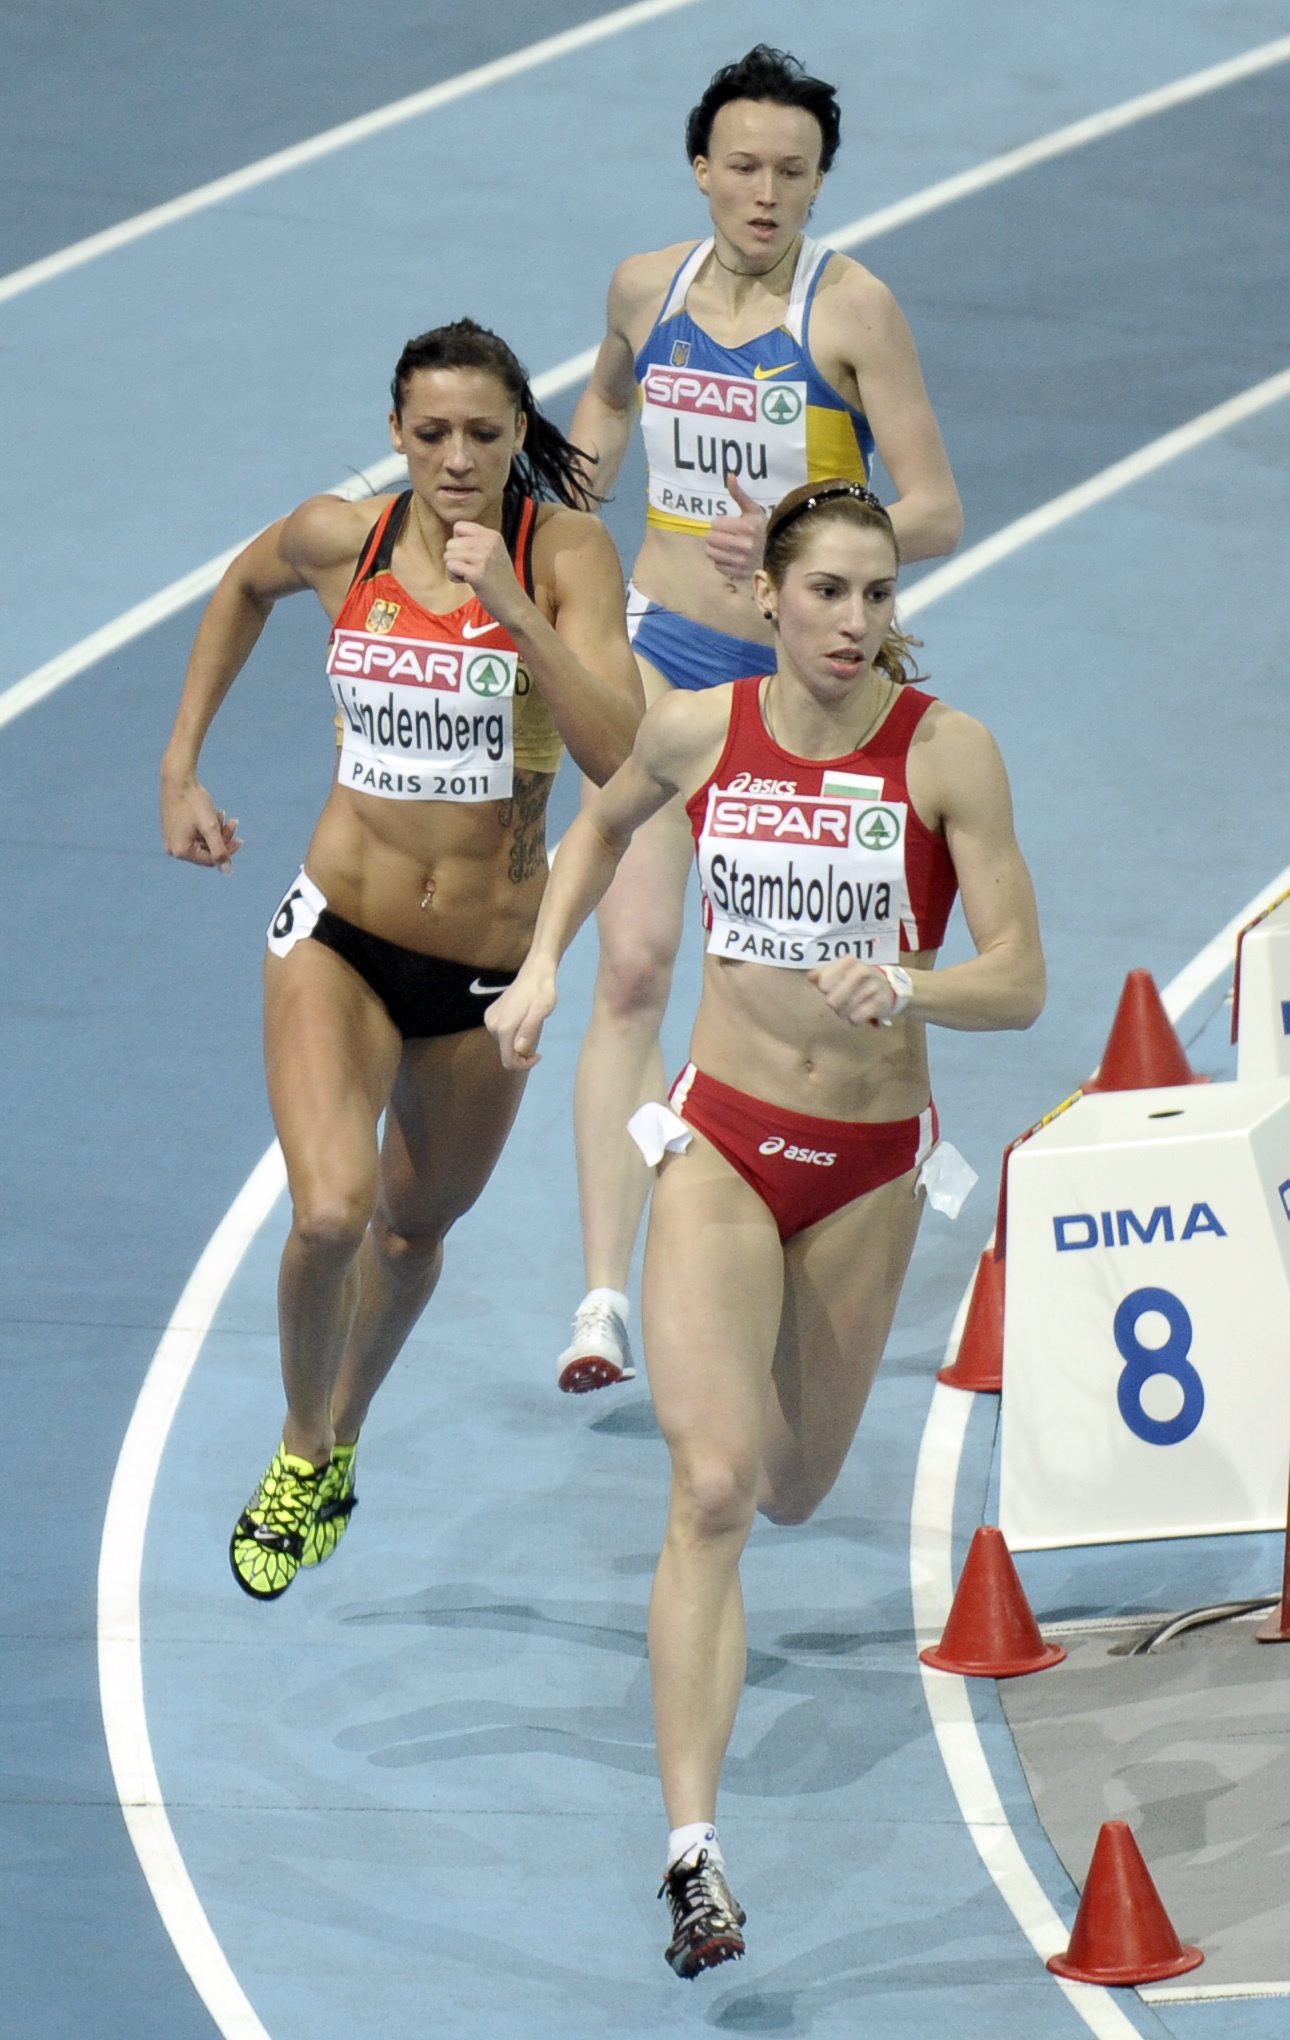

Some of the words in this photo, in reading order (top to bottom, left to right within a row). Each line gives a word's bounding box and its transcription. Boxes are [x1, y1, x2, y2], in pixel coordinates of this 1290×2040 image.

[647, 375, 754, 417] SPAR
[673, 417, 768, 489] Lupu
[662, 488, 728, 517] PARIS
[334, 641, 459, 686] SPAR
[337, 683, 504, 761] Lindenberg
[352, 762, 422, 793] PARIS
[433, 775, 489, 795] 2011
[713, 801, 847, 842] SPAR
[710, 854, 891, 924] Stambolova
[725, 930, 804, 961] PARIS
[817, 939, 875, 962] 2011
[783, 1145, 837, 1167] asics
[1053, 1202, 1228, 1252] DIMA
[1113, 1286, 1206, 1446] 8
